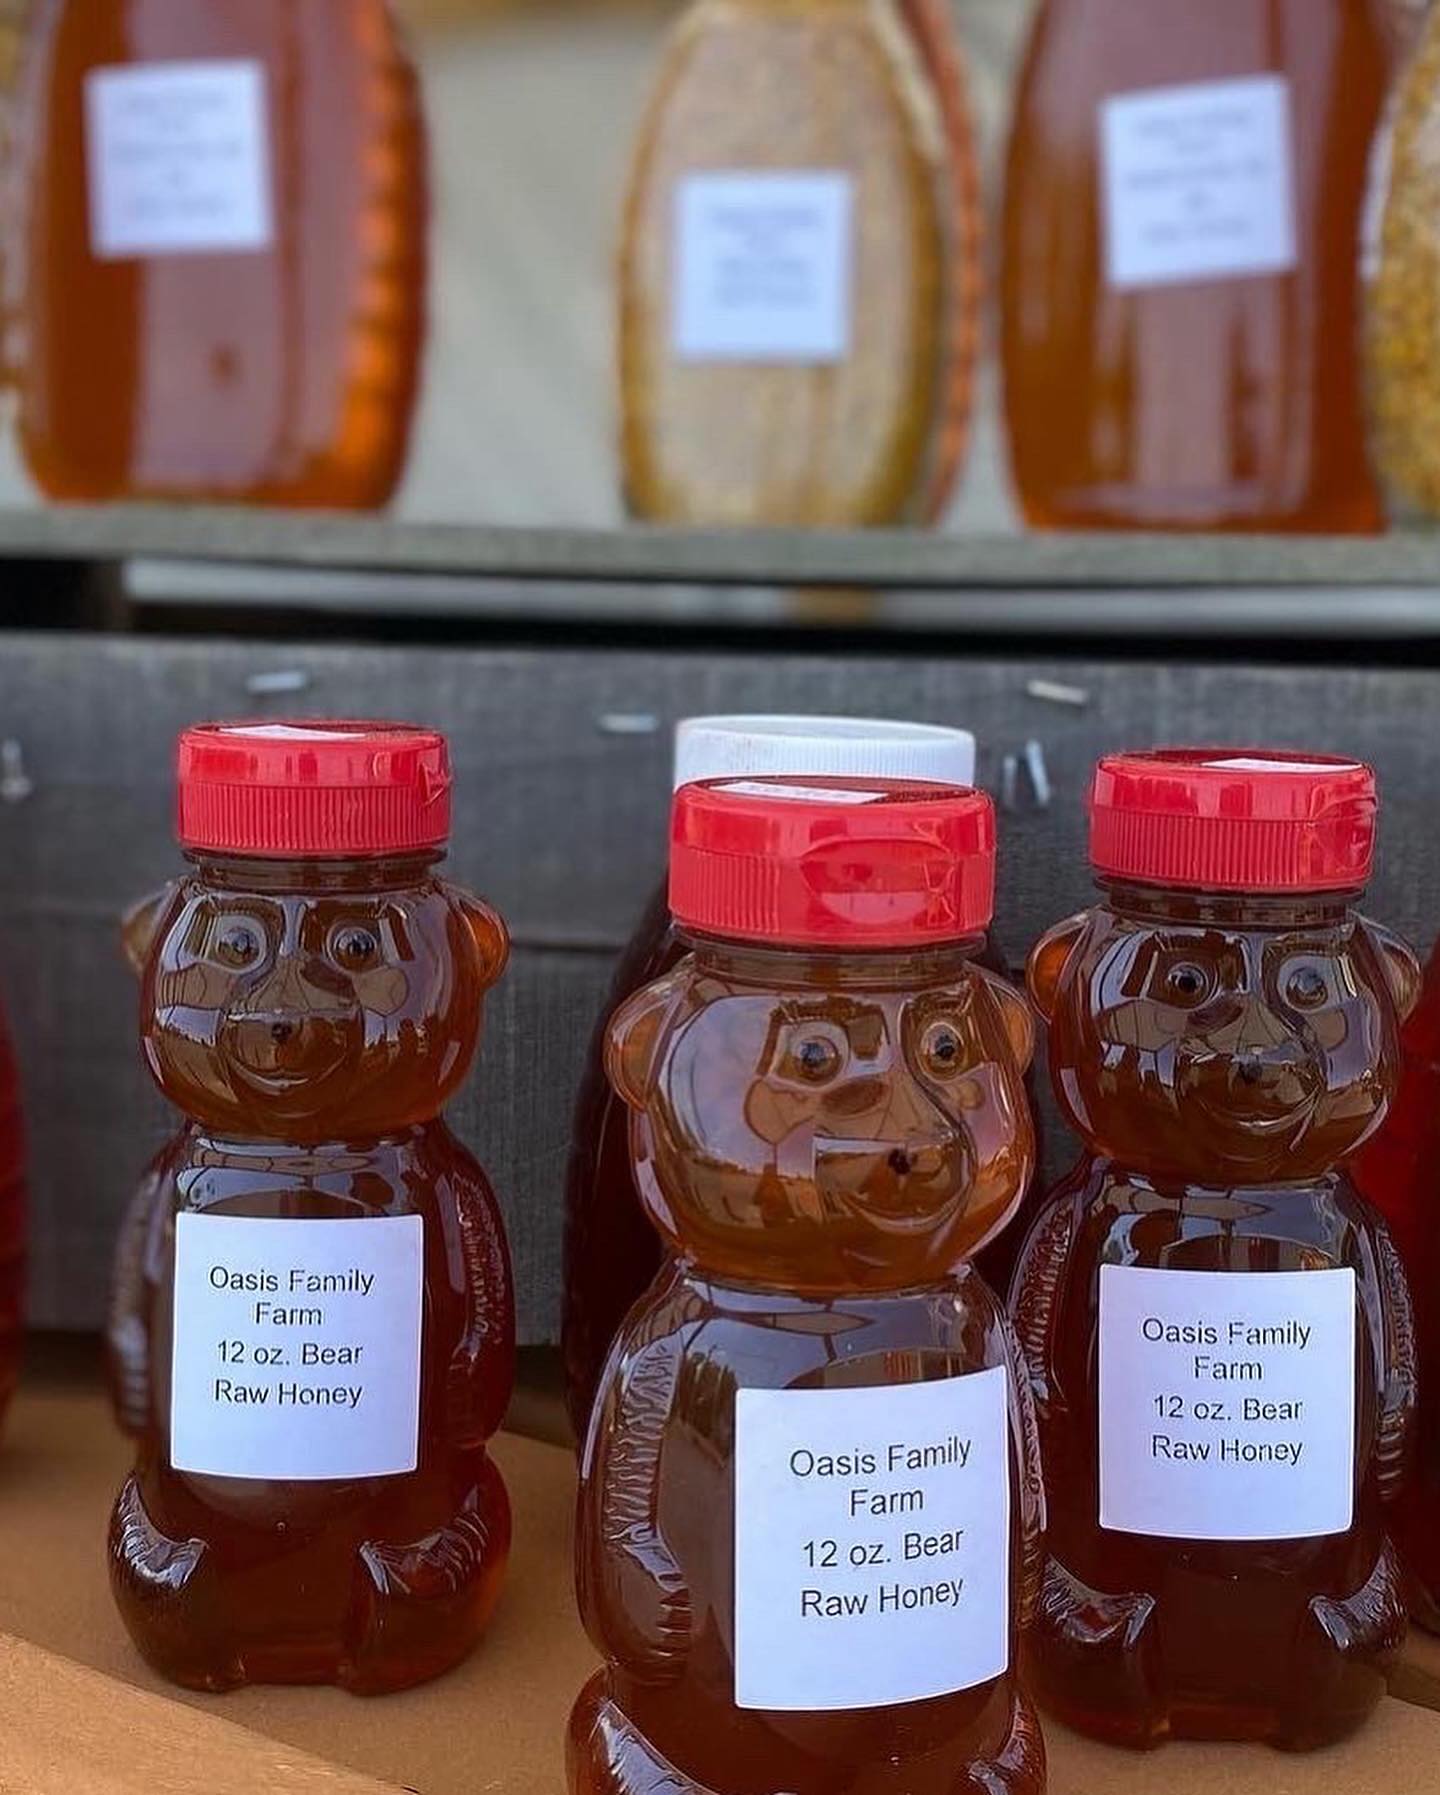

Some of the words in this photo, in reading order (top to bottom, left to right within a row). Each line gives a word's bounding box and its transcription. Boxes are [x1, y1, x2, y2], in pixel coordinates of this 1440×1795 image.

[210, 1266, 278, 1292] Oasis
[290, 1269, 374, 1296] Family
[256, 1302, 322, 1325] Farm
[1143, 1318, 1217, 1344] Oasis
[1229, 1321, 1311, 1350] Family
[218, 1340, 244, 1363] 12
[254, 1348, 289, 1365] oz.
[302, 1343, 363, 1365] Bear
[1195, 1356, 1262, 1380] Farm
[214, 1380, 269, 1404] Raw
[279, 1383, 362, 1409] Honey
[1155, 1395, 1184, 1418] 12
[1194, 1403, 1231, 1421] oz.
[1243, 1398, 1303, 1421] Bear
[790, 1448, 876, 1477] Oasis
[889, 1436, 971, 1472] Family
[1153, 1435, 1210, 1460] Raw
[1221, 1439, 1302, 1466] Honey
[851, 1489, 923, 1516] Farm
[804, 1540, 838, 1567] 12
[850, 1544, 891, 1568] oz.
[905, 1530, 963, 1560] Bear
[802, 1590, 868, 1617] Raw
[880, 1579, 963, 1613] Honey
